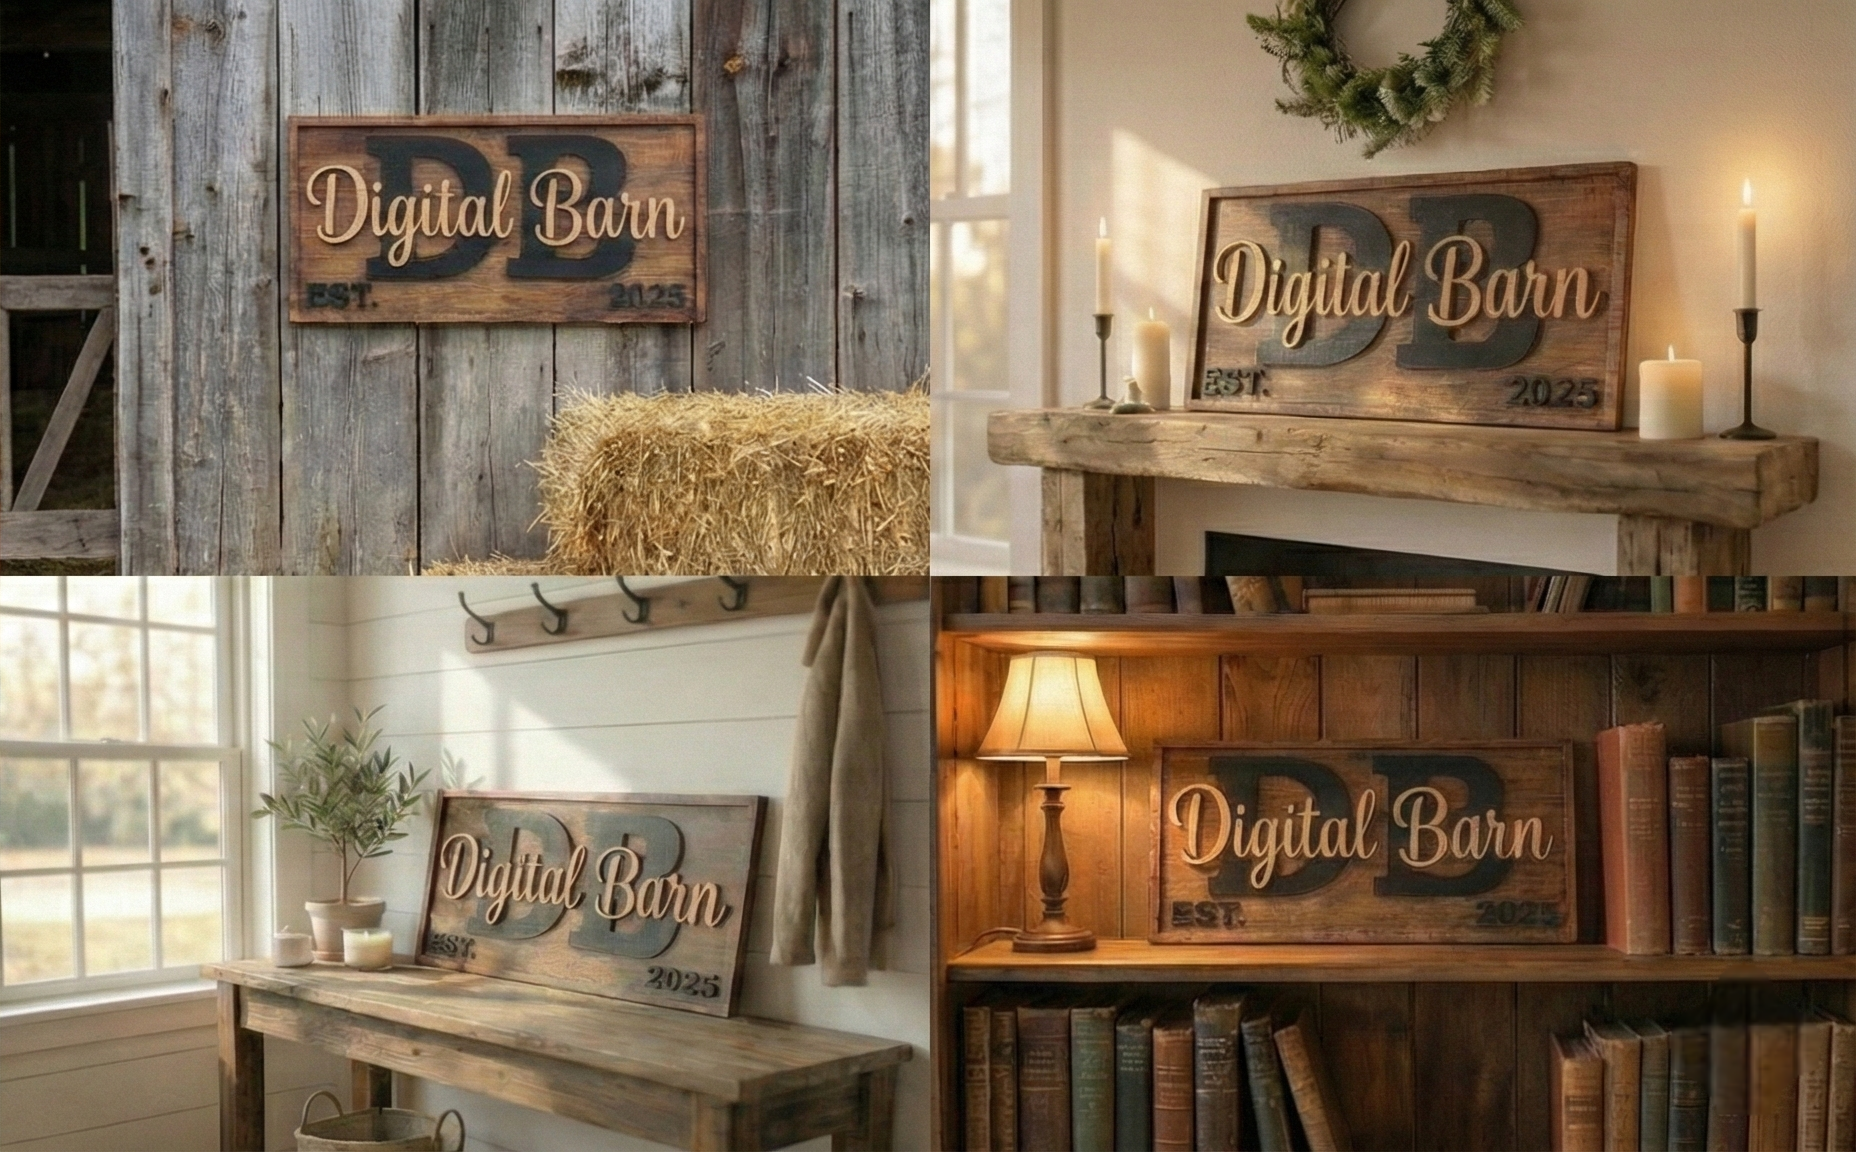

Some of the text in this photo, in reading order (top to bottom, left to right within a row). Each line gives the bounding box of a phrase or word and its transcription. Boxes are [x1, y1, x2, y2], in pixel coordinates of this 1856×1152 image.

[306, 165, 685, 268] Digital Barn
[306, 282, 687, 311] EST. 2025
[1213, 235, 1601, 349] Digital Barn
[1204, 368, 1600, 409] EST. 2025
[1168, 783, 1378, 890] Digital
[1393, 787, 1553, 868] Barn
[440, 833, 730, 928] Digital Barn
[1173, 901, 1246, 929] EST.
[646, 965, 721, 999] 2025
